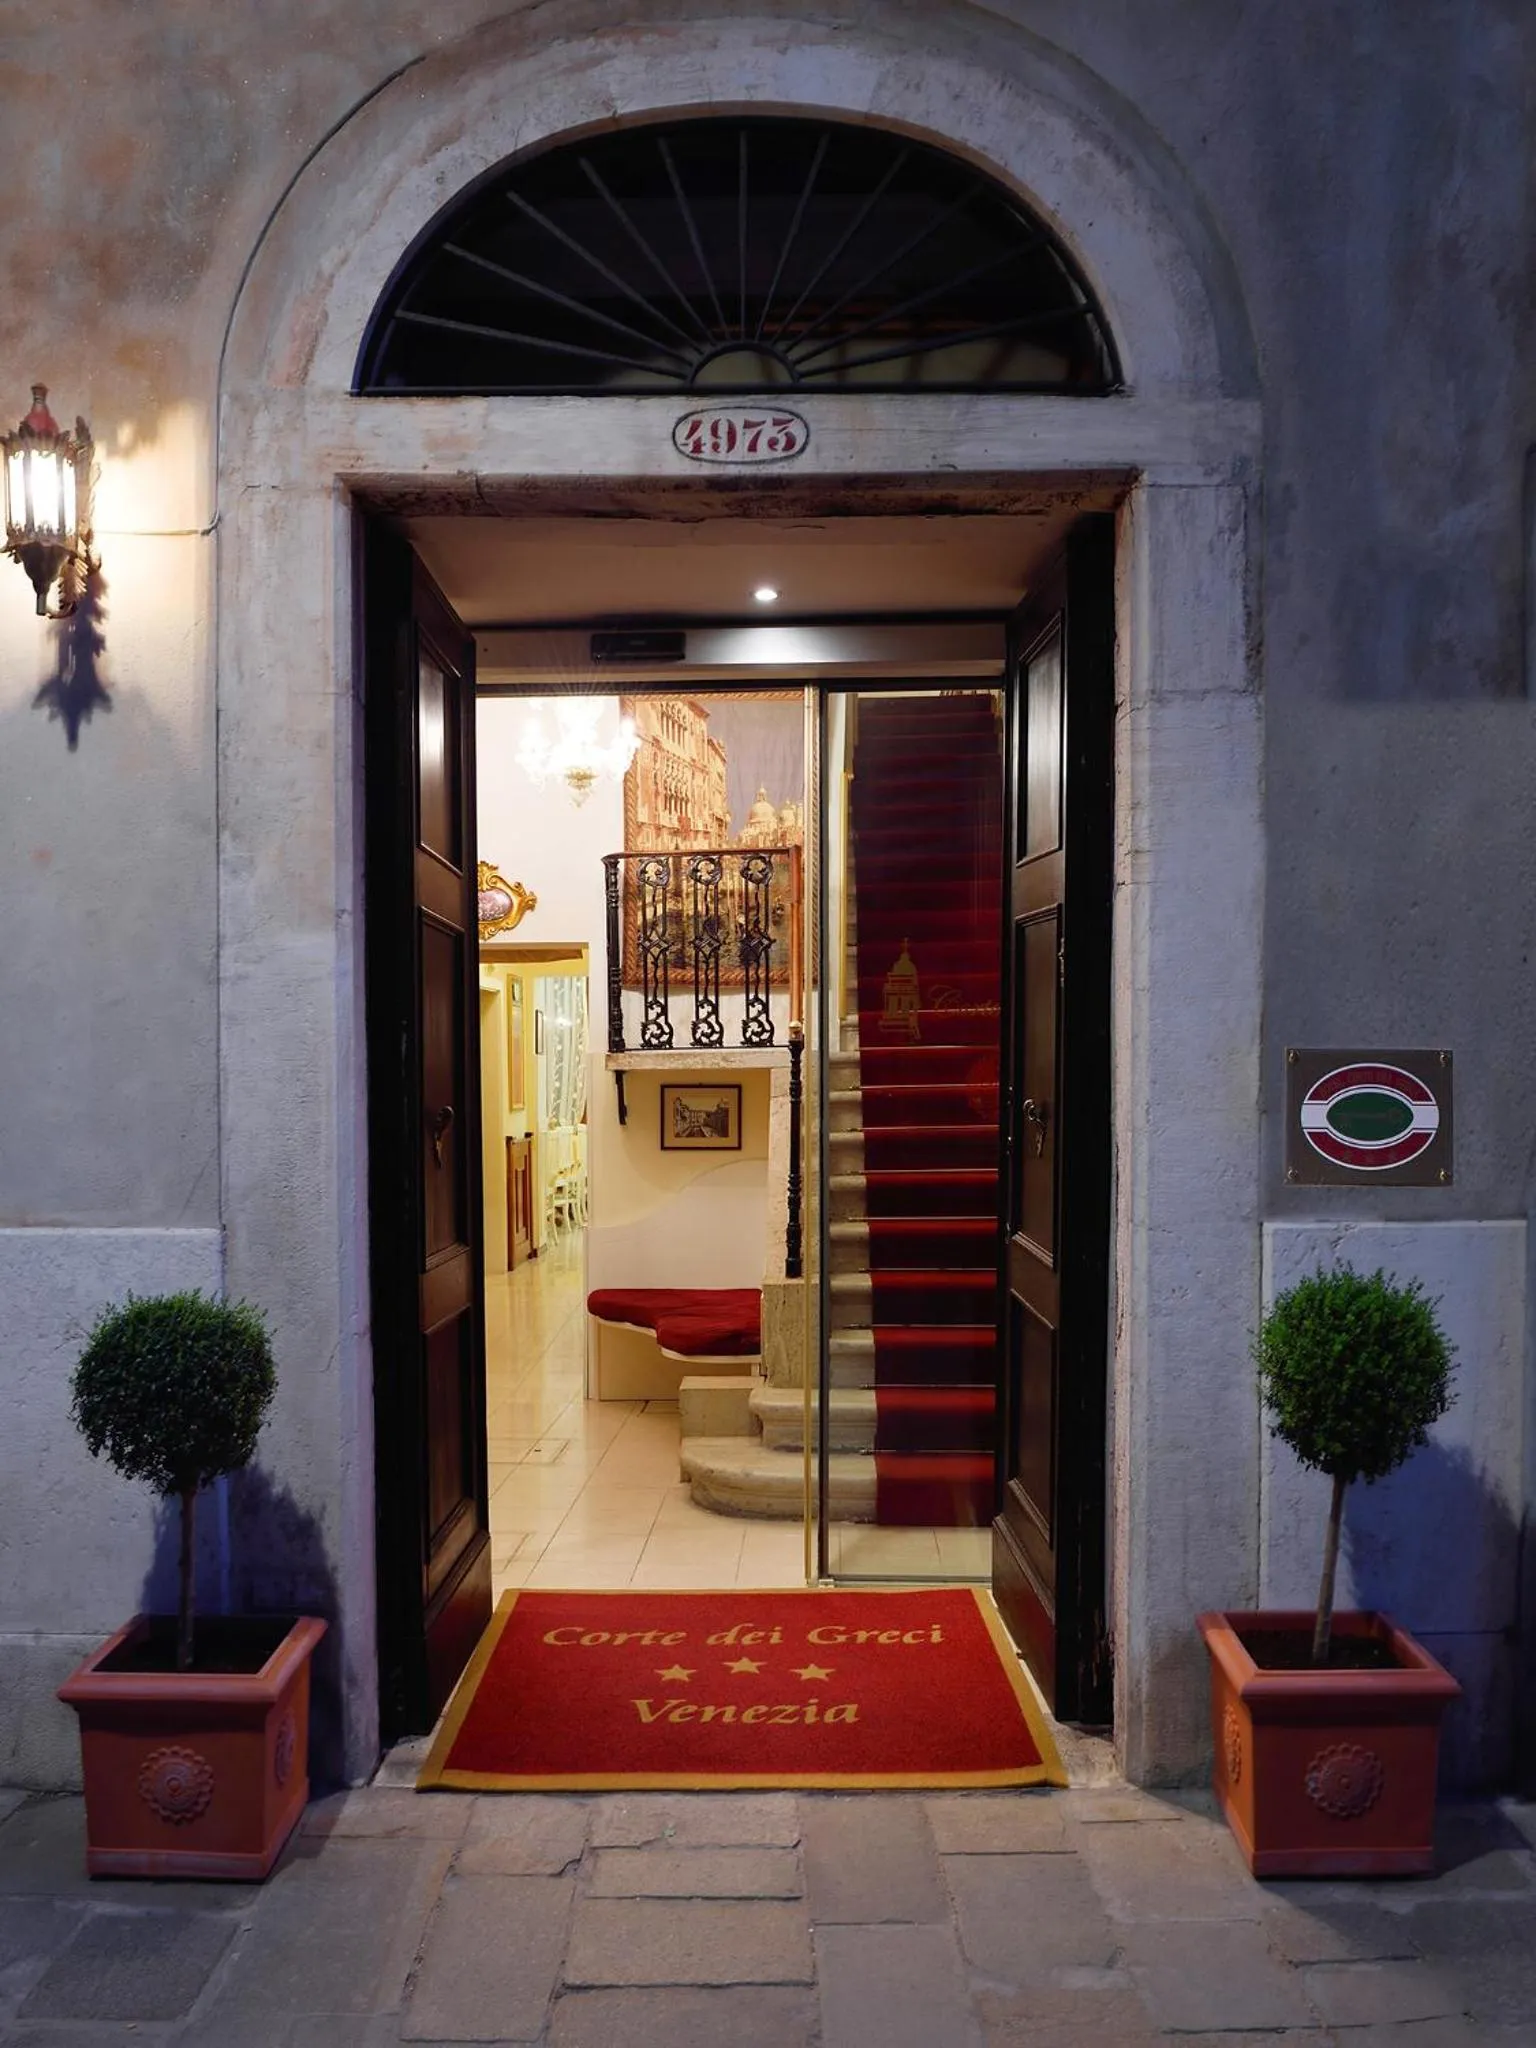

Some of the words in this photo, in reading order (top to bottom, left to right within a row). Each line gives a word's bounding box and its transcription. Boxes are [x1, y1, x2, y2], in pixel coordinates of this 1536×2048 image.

[680, 417, 797, 453] 4973
[543, 1626, 687, 1646] Corte
[706, 1623, 784, 1645] dei
[807, 1624, 945, 1645] Greci
[631, 1699, 860, 1724] Venezia
